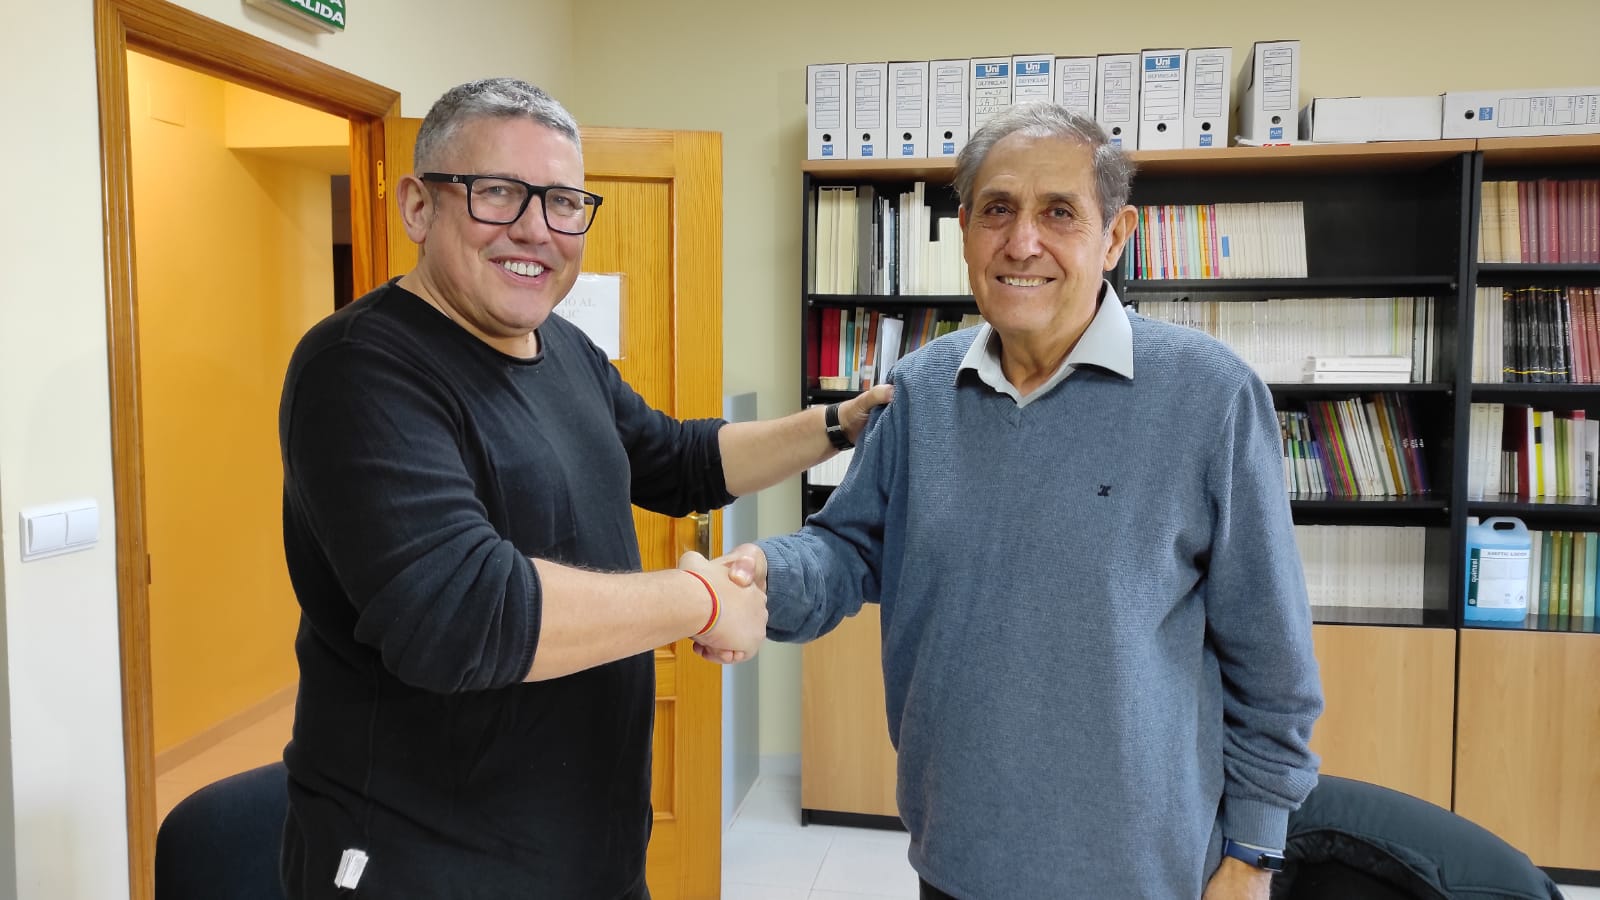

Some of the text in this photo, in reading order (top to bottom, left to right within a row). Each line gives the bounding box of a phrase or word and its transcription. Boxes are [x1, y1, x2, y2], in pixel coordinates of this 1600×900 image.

[1025, 61, 1041, 71] Uni
[1155, 57, 1171, 66] Uni
[985, 64, 1000, 73] Uni
